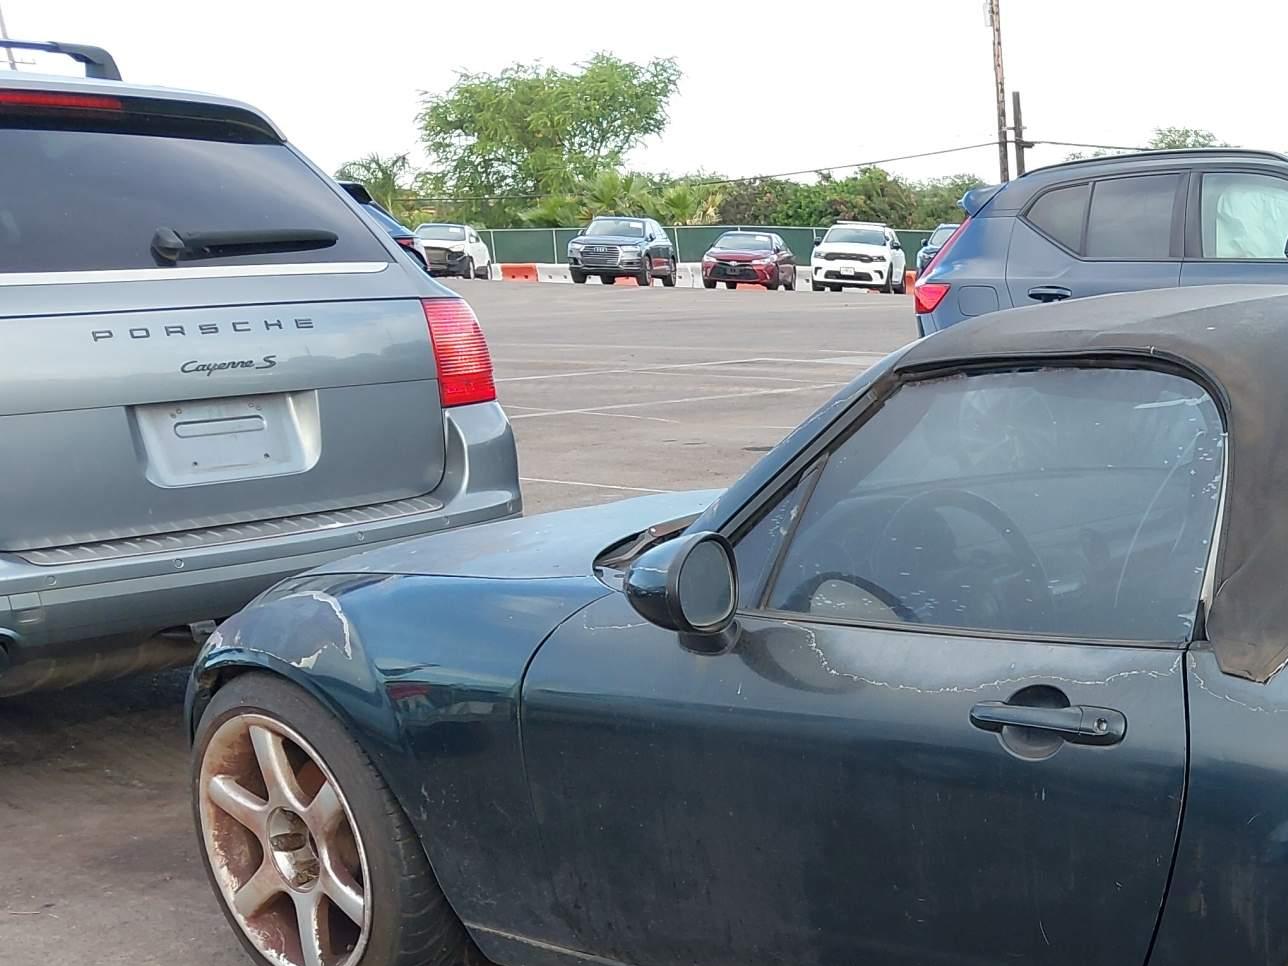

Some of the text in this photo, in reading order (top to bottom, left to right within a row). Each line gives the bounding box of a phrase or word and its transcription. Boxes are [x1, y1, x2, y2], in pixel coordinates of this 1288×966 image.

[91, 318, 315, 342] PORSCHE
[180, 355, 277, 377] Cayenne S
